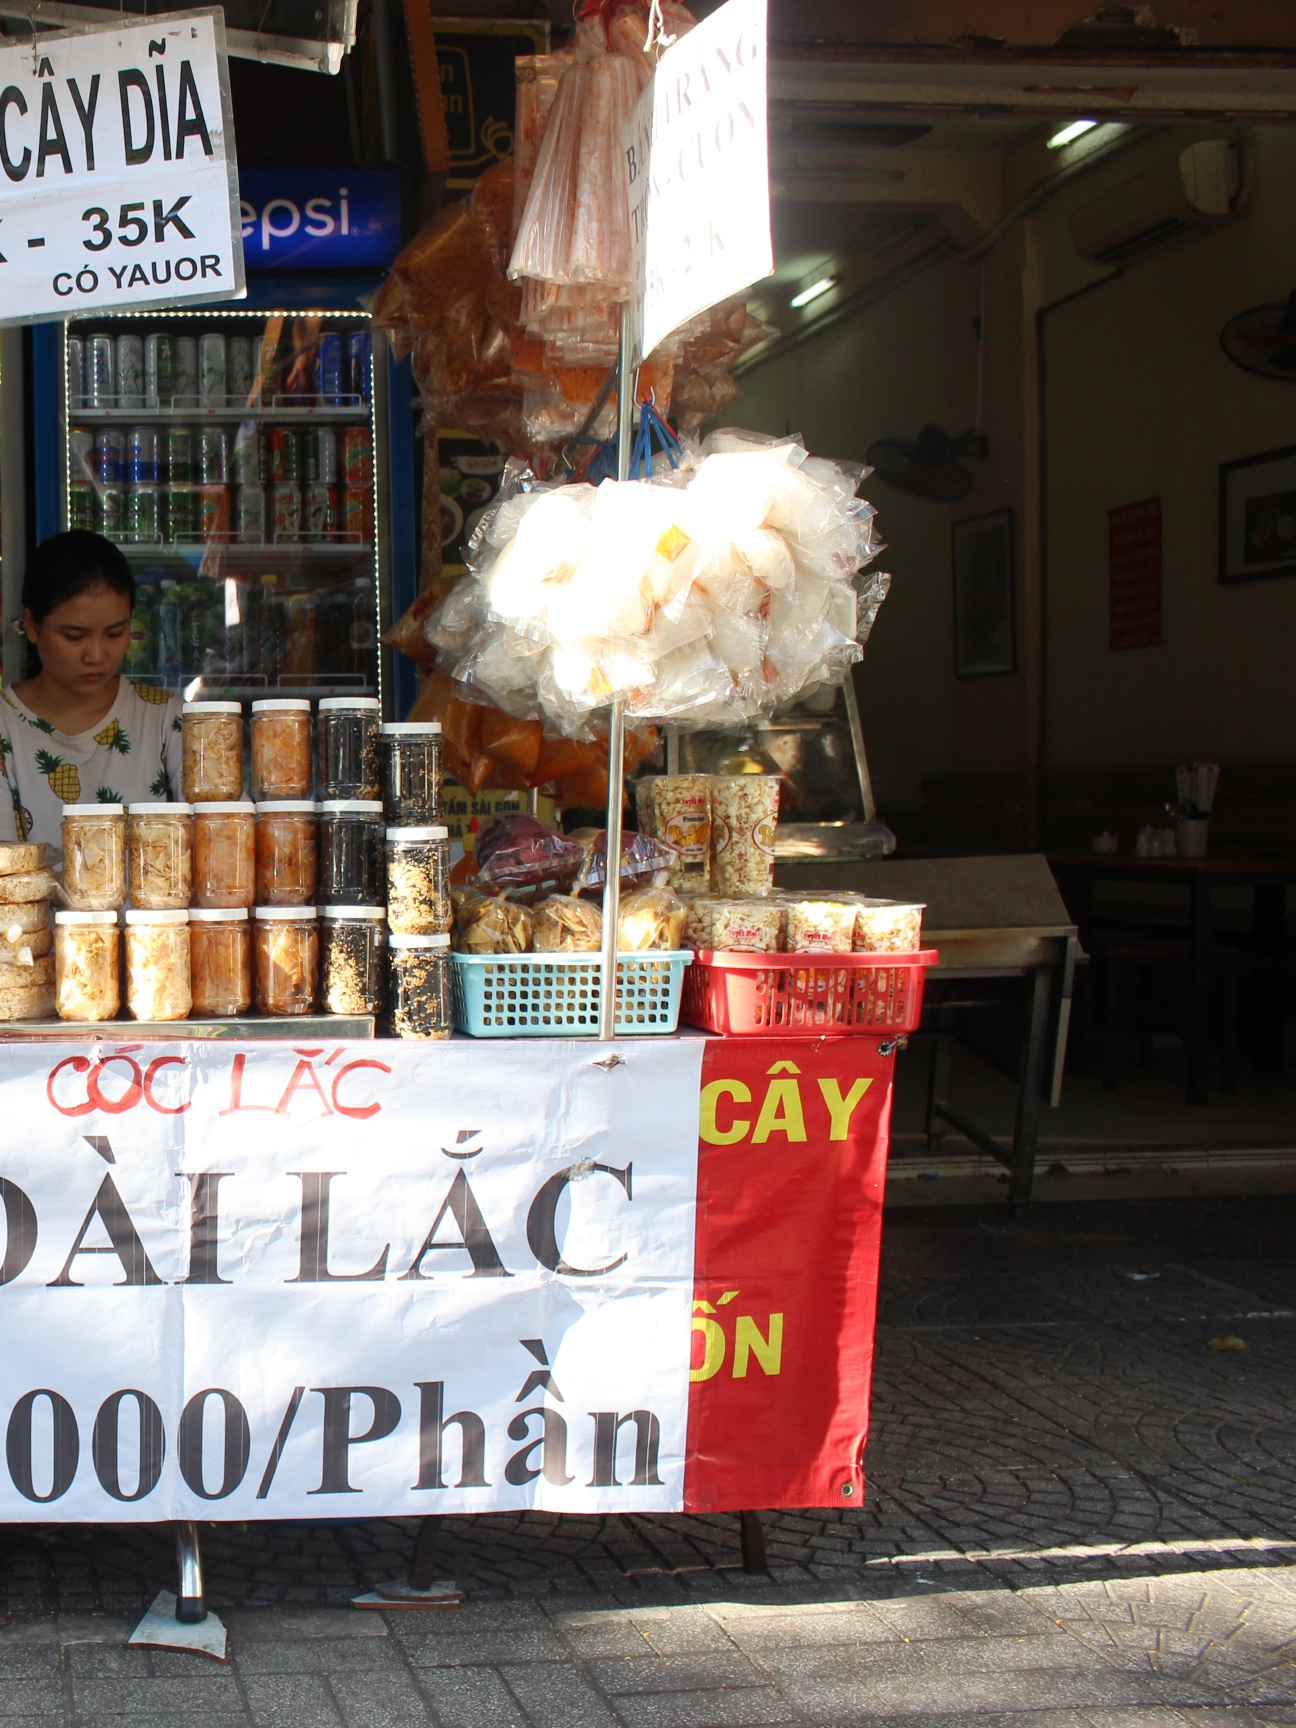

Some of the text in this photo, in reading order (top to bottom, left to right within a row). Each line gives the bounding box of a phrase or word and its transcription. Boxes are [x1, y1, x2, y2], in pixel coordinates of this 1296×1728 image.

[117, 38, 214, 167] DĨA
[80, 195, 197, 252] 35K
[241, 187, 349, 250] epsi
[52, 254, 223, 297] CÓ YAUOR
[218, 1046, 392, 1120] LẮC
[698, 1060, 874, 1146] CÂY
[284, 1129, 635, 1285] LẮC
[689, 1291, 784, 1383] ỐN
